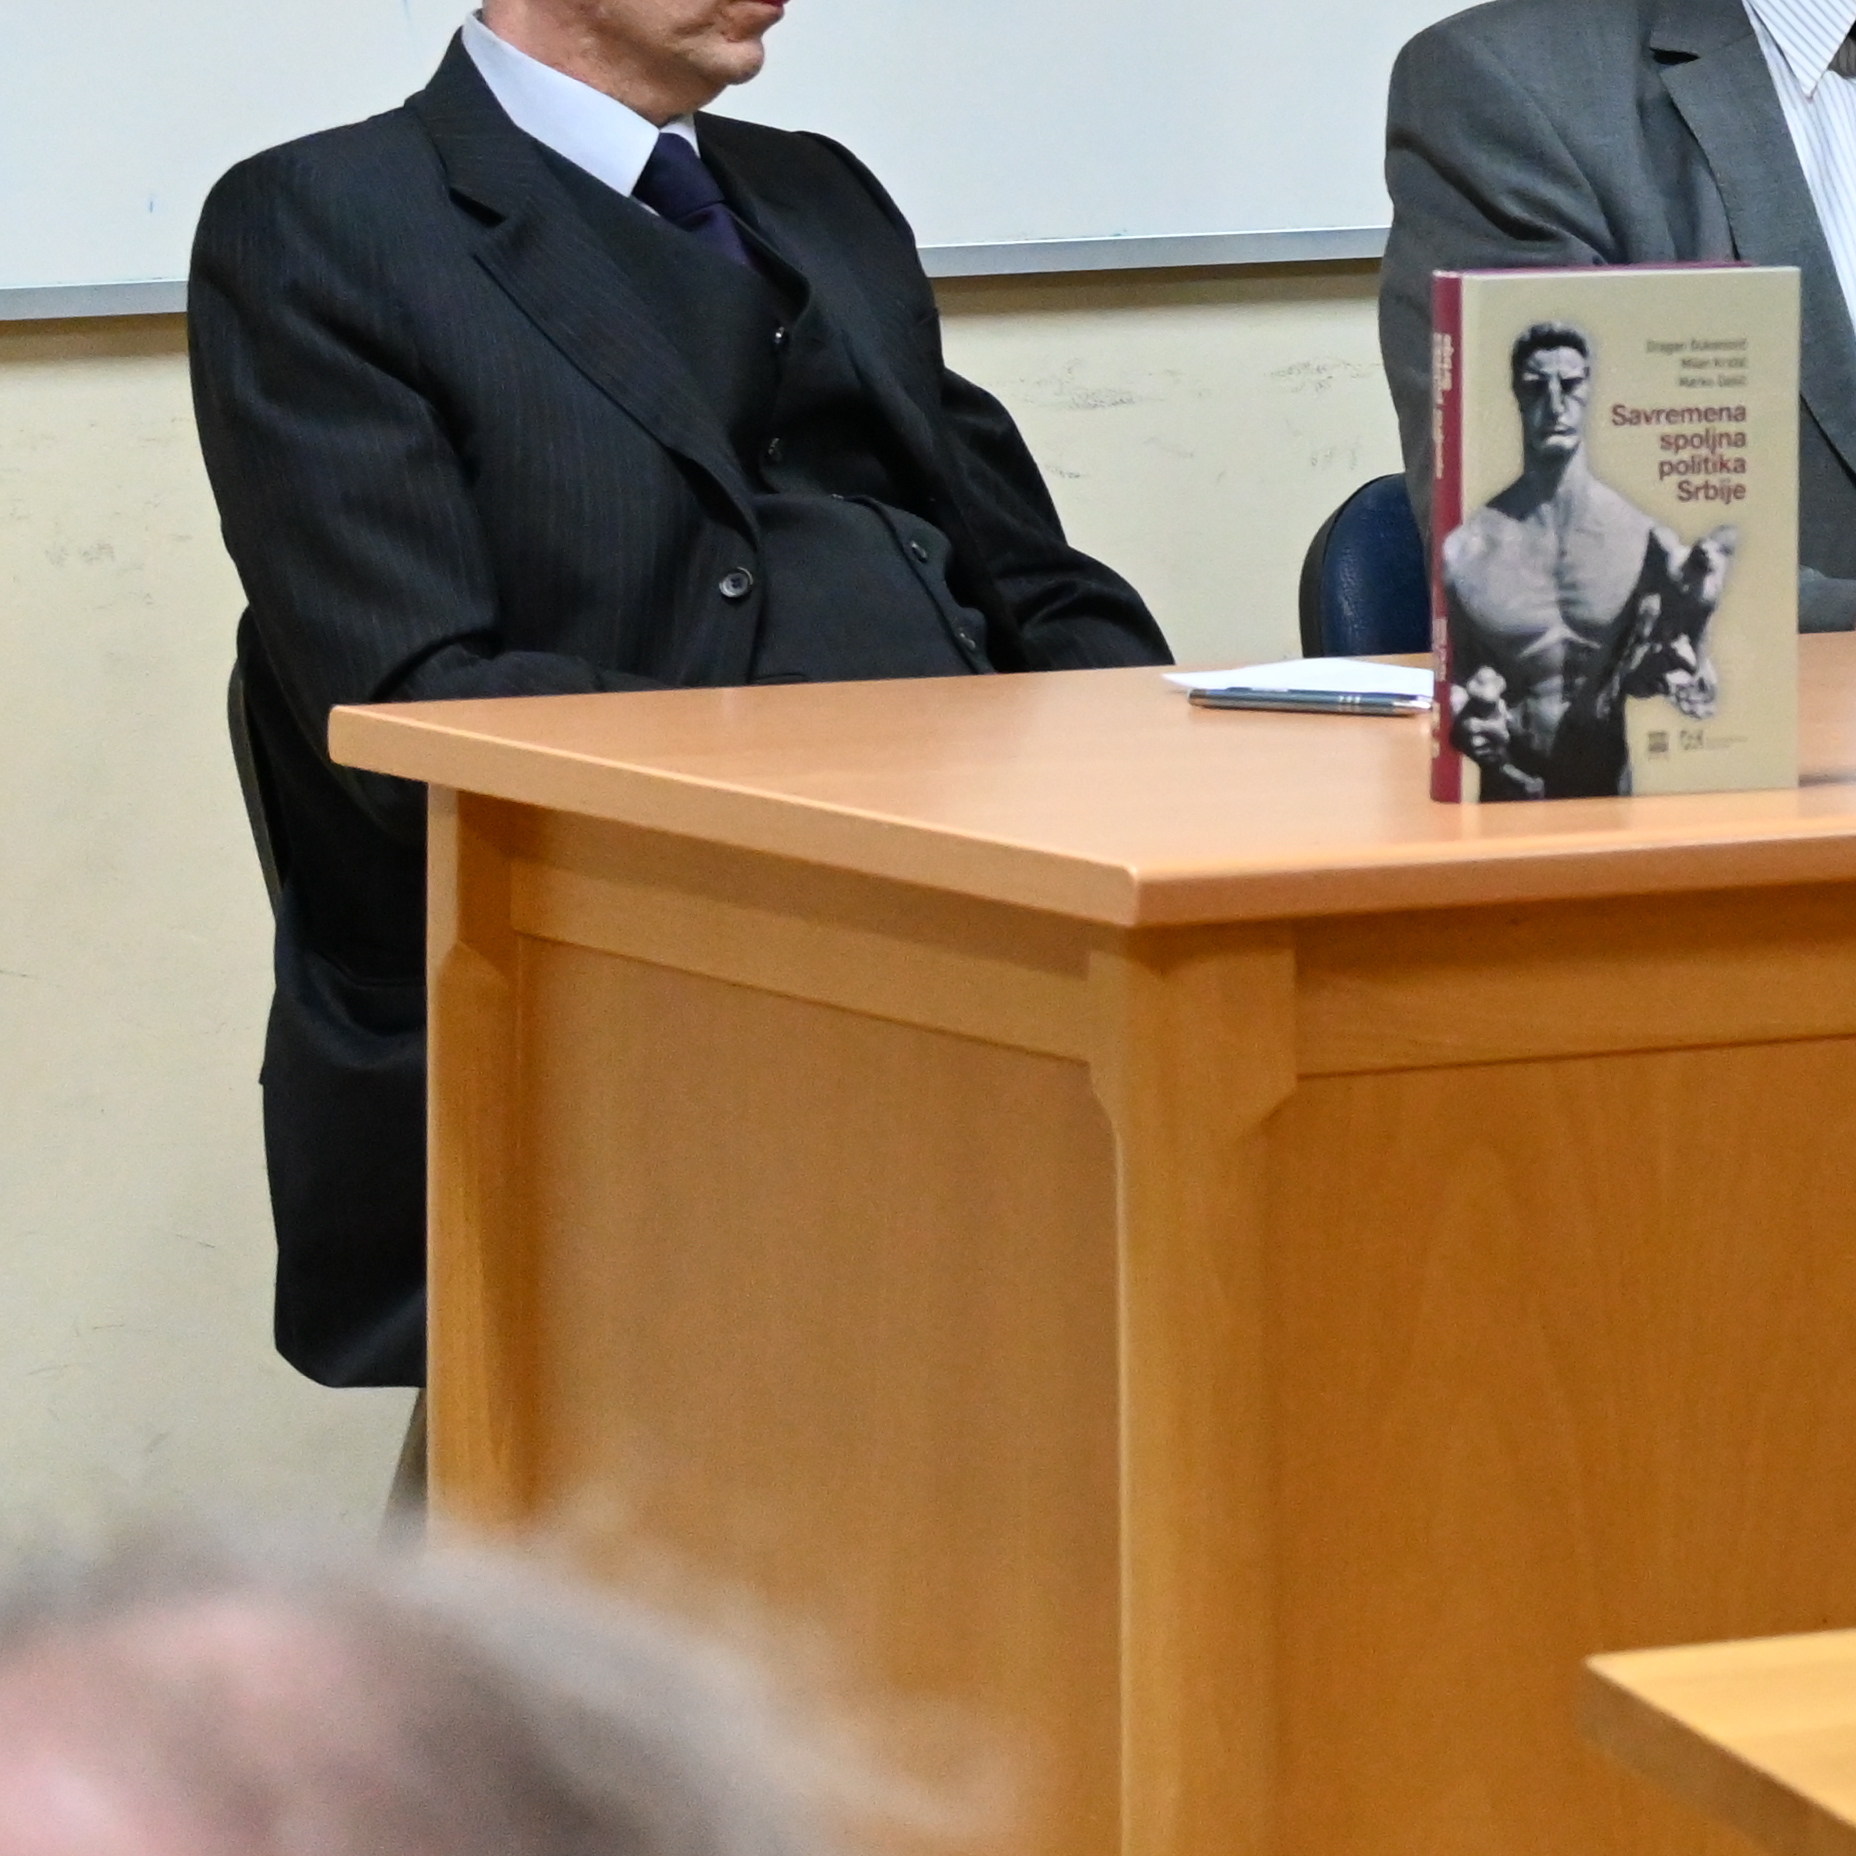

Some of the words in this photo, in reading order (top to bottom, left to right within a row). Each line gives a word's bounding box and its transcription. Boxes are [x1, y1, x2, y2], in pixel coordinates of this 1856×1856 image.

[1611, 404, 1747, 426] Savremena
[1660, 426, 1747, 455] spoljna
[1658, 454, 1746, 480] politika
[1677, 479, 1746, 505] Srbije
